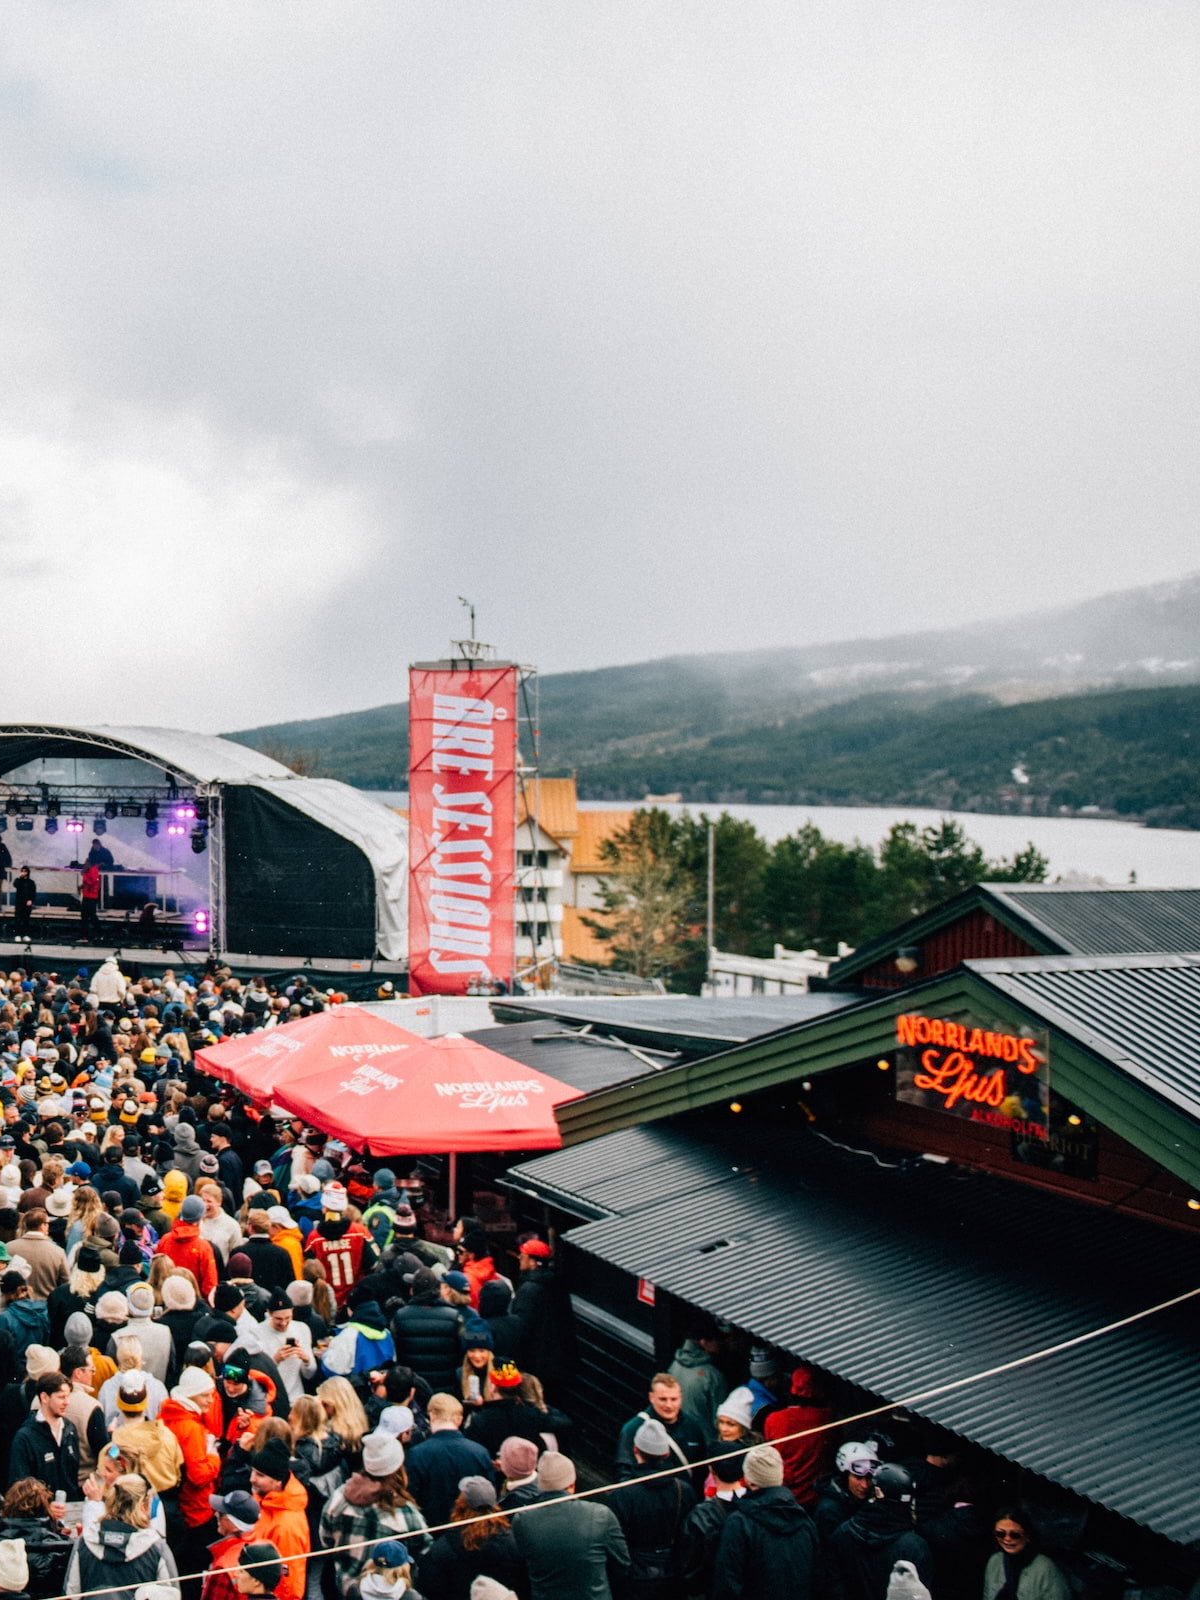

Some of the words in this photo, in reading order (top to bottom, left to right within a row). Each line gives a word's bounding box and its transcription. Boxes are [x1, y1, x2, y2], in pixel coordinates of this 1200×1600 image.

[432, 693, 508, 781] ÅRE
[428, 783, 494, 982] SESSIONS
[897, 1014, 1042, 1075] NORRLANDS
[433, 1079, 545, 1097] NORRLANDS
[458, 1091, 528, 1114] Ljus
[913, 1049, 1006, 1109] Ljus
[327, 1251, 354, 1287] 11
